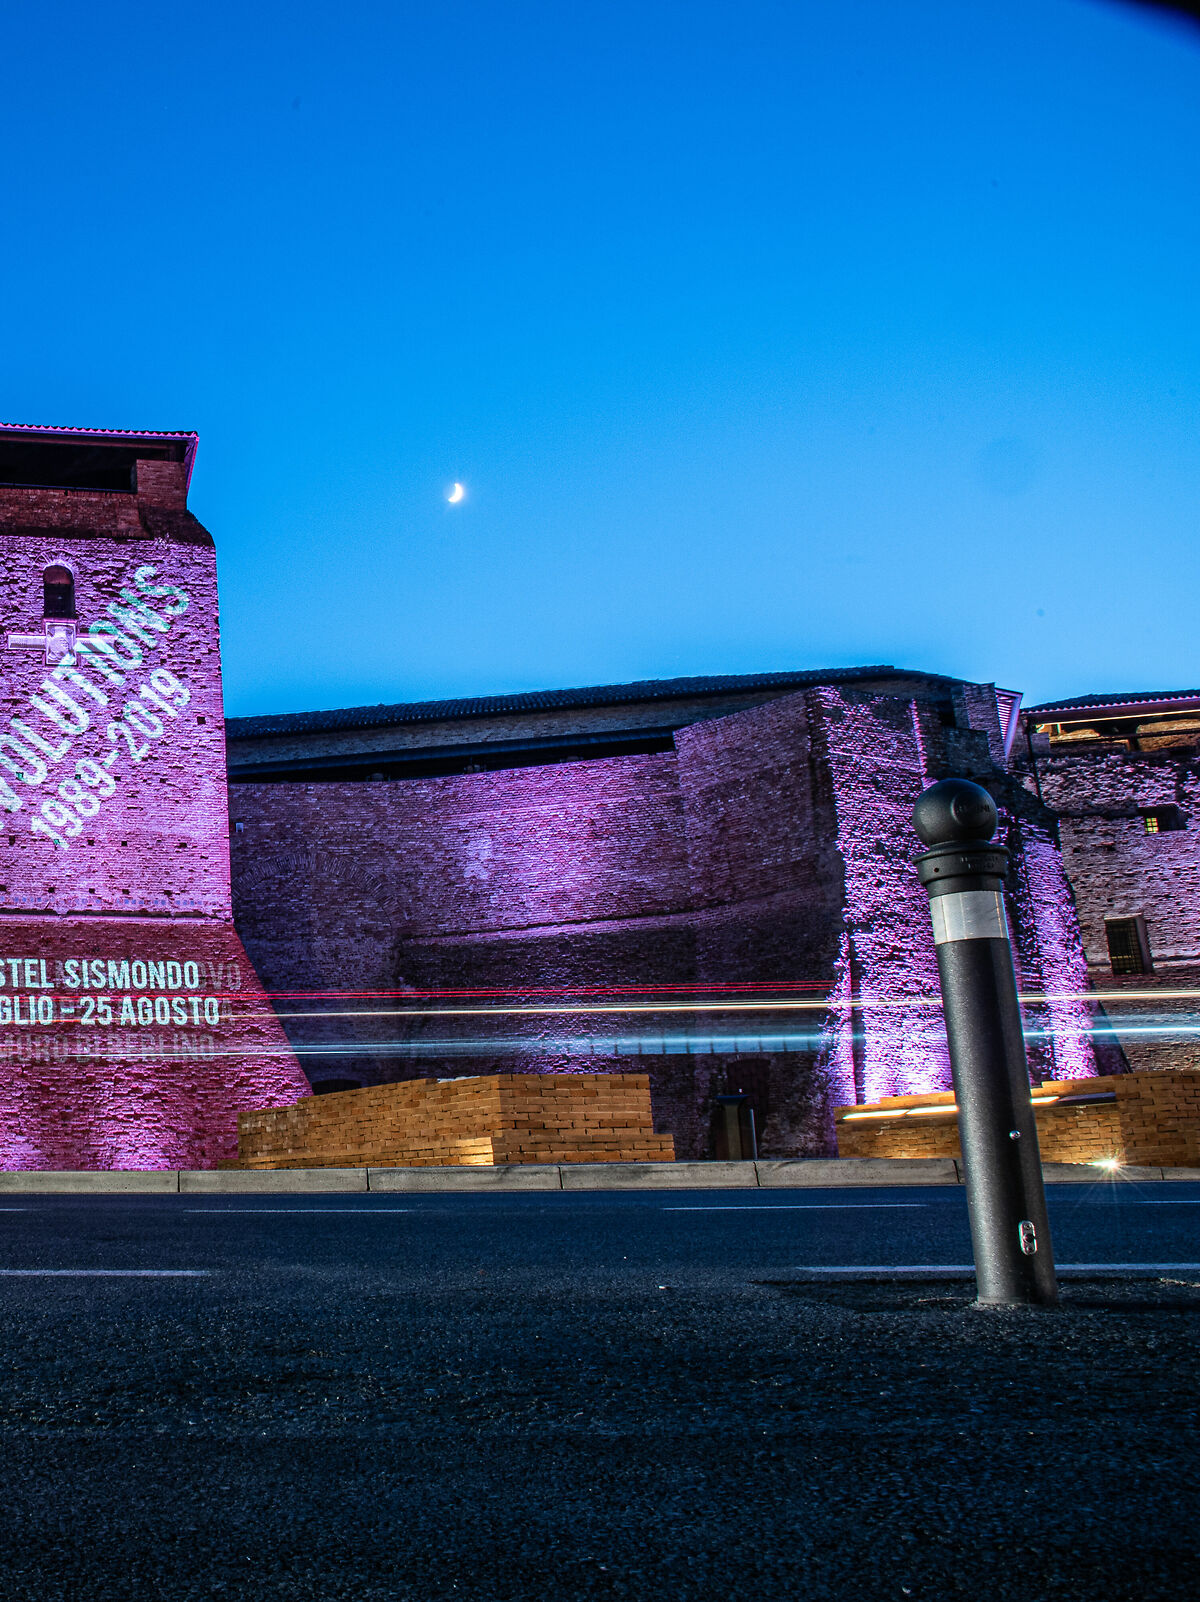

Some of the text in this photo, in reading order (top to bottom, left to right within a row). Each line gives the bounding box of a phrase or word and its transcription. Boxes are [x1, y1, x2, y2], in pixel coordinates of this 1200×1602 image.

[31, 668, 191, 850] 1989-2019
[64, 958, 199, 990] SISMONDO
[81, 996, 112, 1026] 25
[120, 996, 220, 1026] AGOSTO
